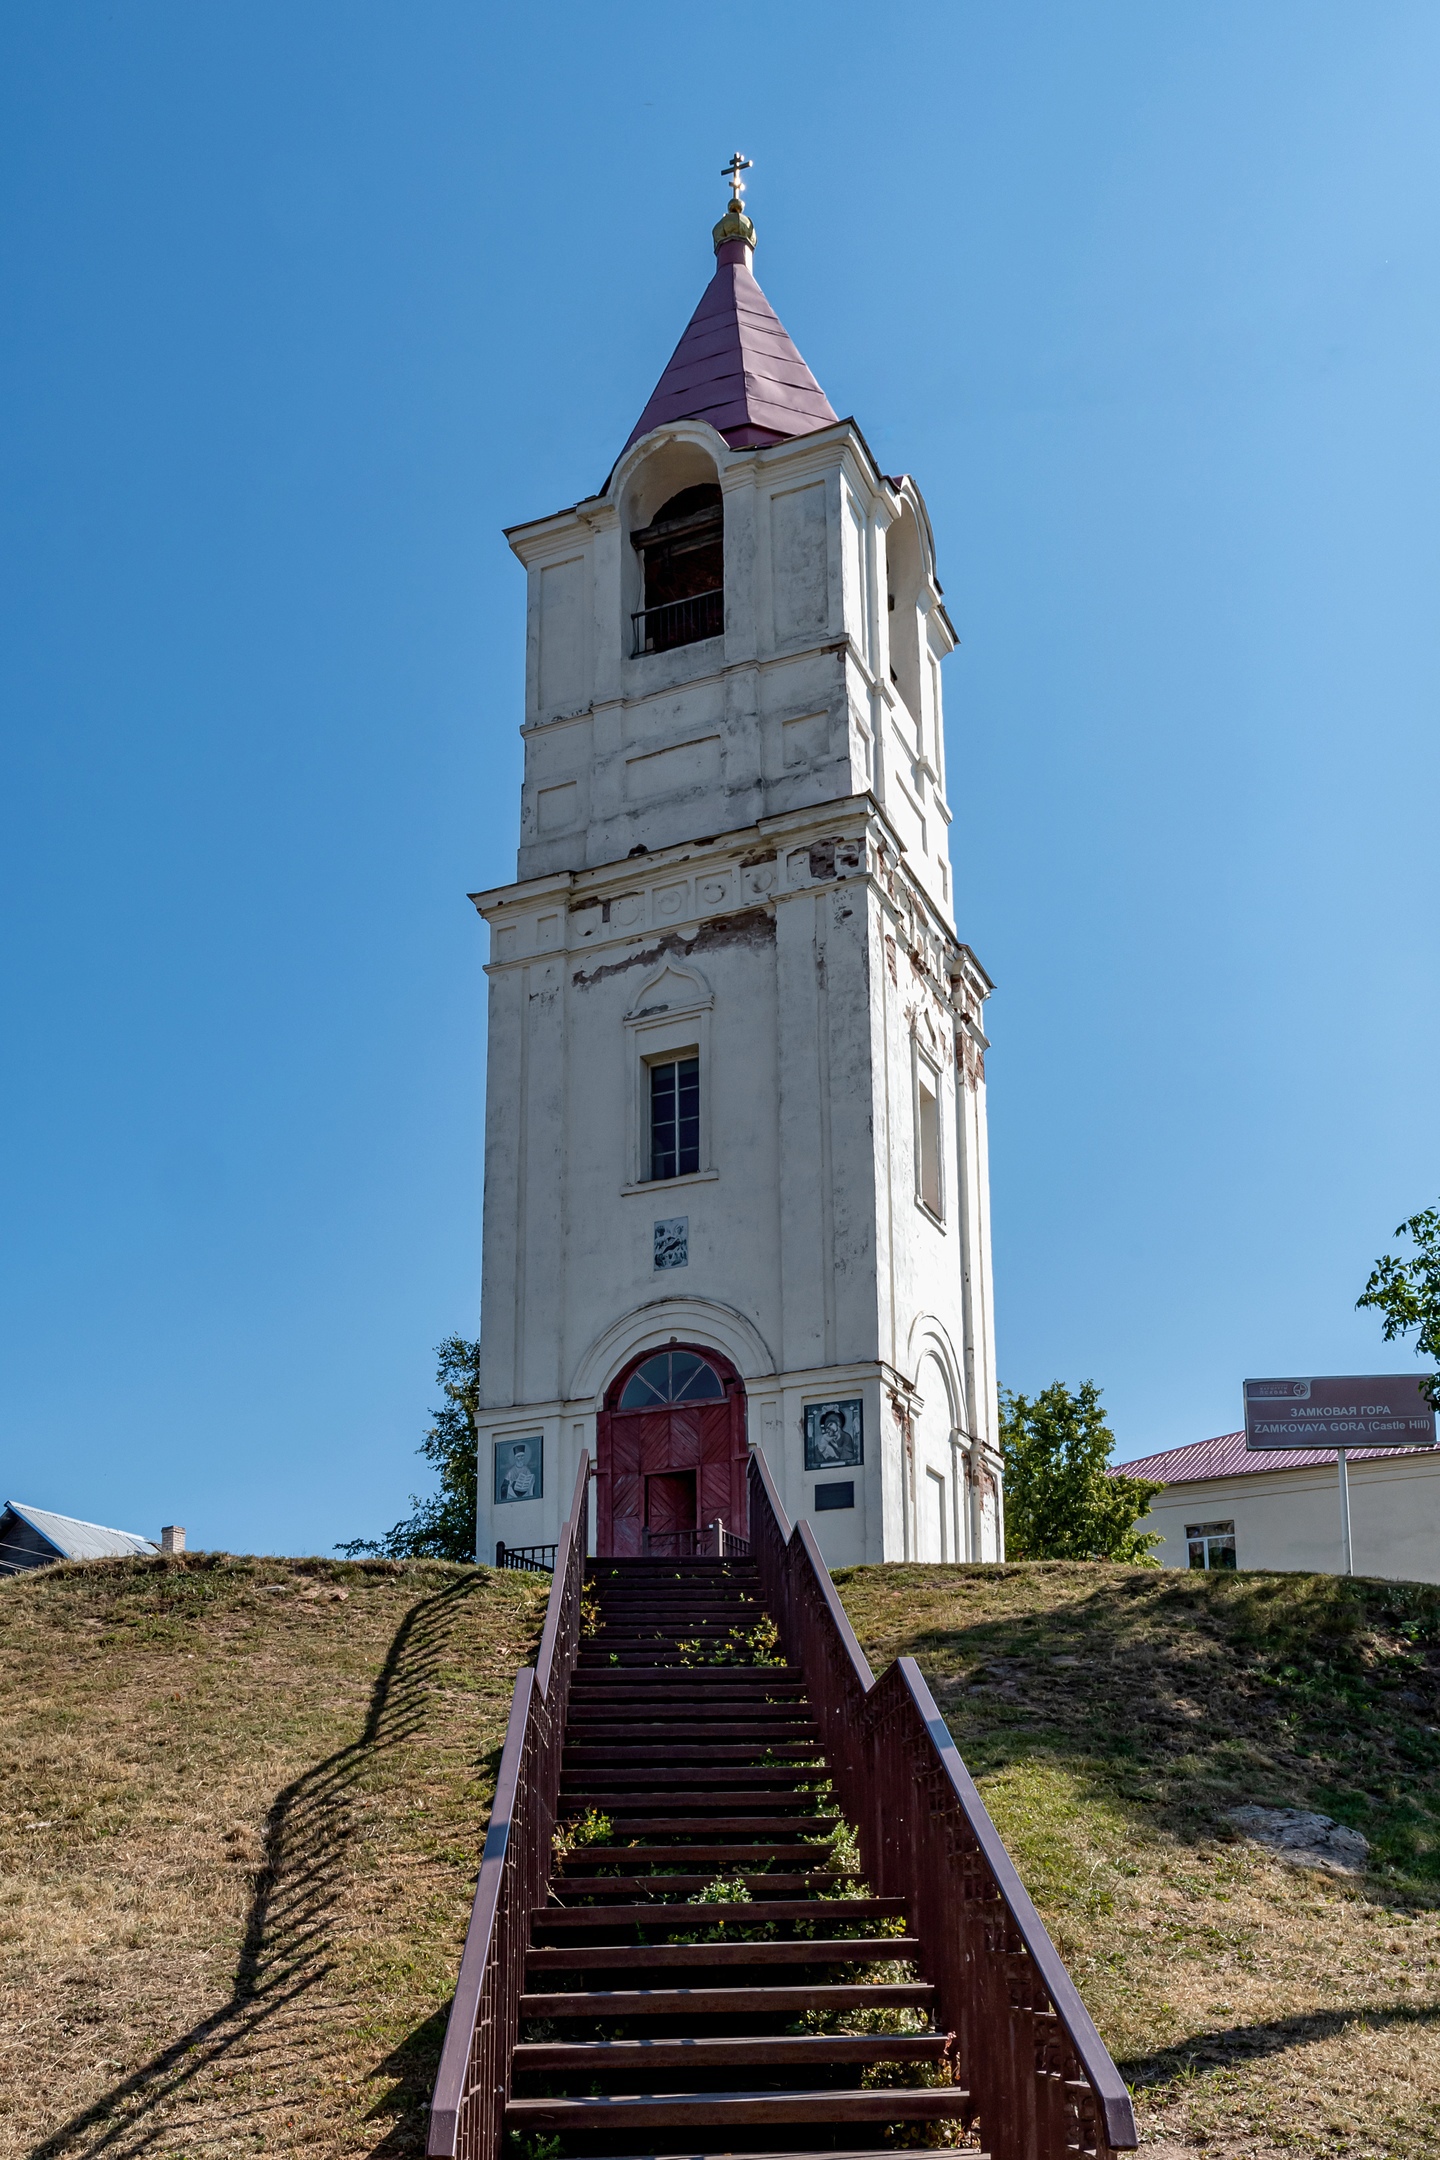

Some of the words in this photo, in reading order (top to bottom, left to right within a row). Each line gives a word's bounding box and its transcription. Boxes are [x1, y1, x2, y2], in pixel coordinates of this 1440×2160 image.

[1290, 1406, 1356, 1417] ЗАМКОВАЯ
[1360, 1405, 1391, 1415] ГОРА
[1254, 1422, 1327, 1433] ZAMKOVAYA
[1330, 1422, 1365, 1432] GORA
[1368, 1420, 1406, 1432] (Castle
[1409, 1420, 1430, 1430] Hill)
